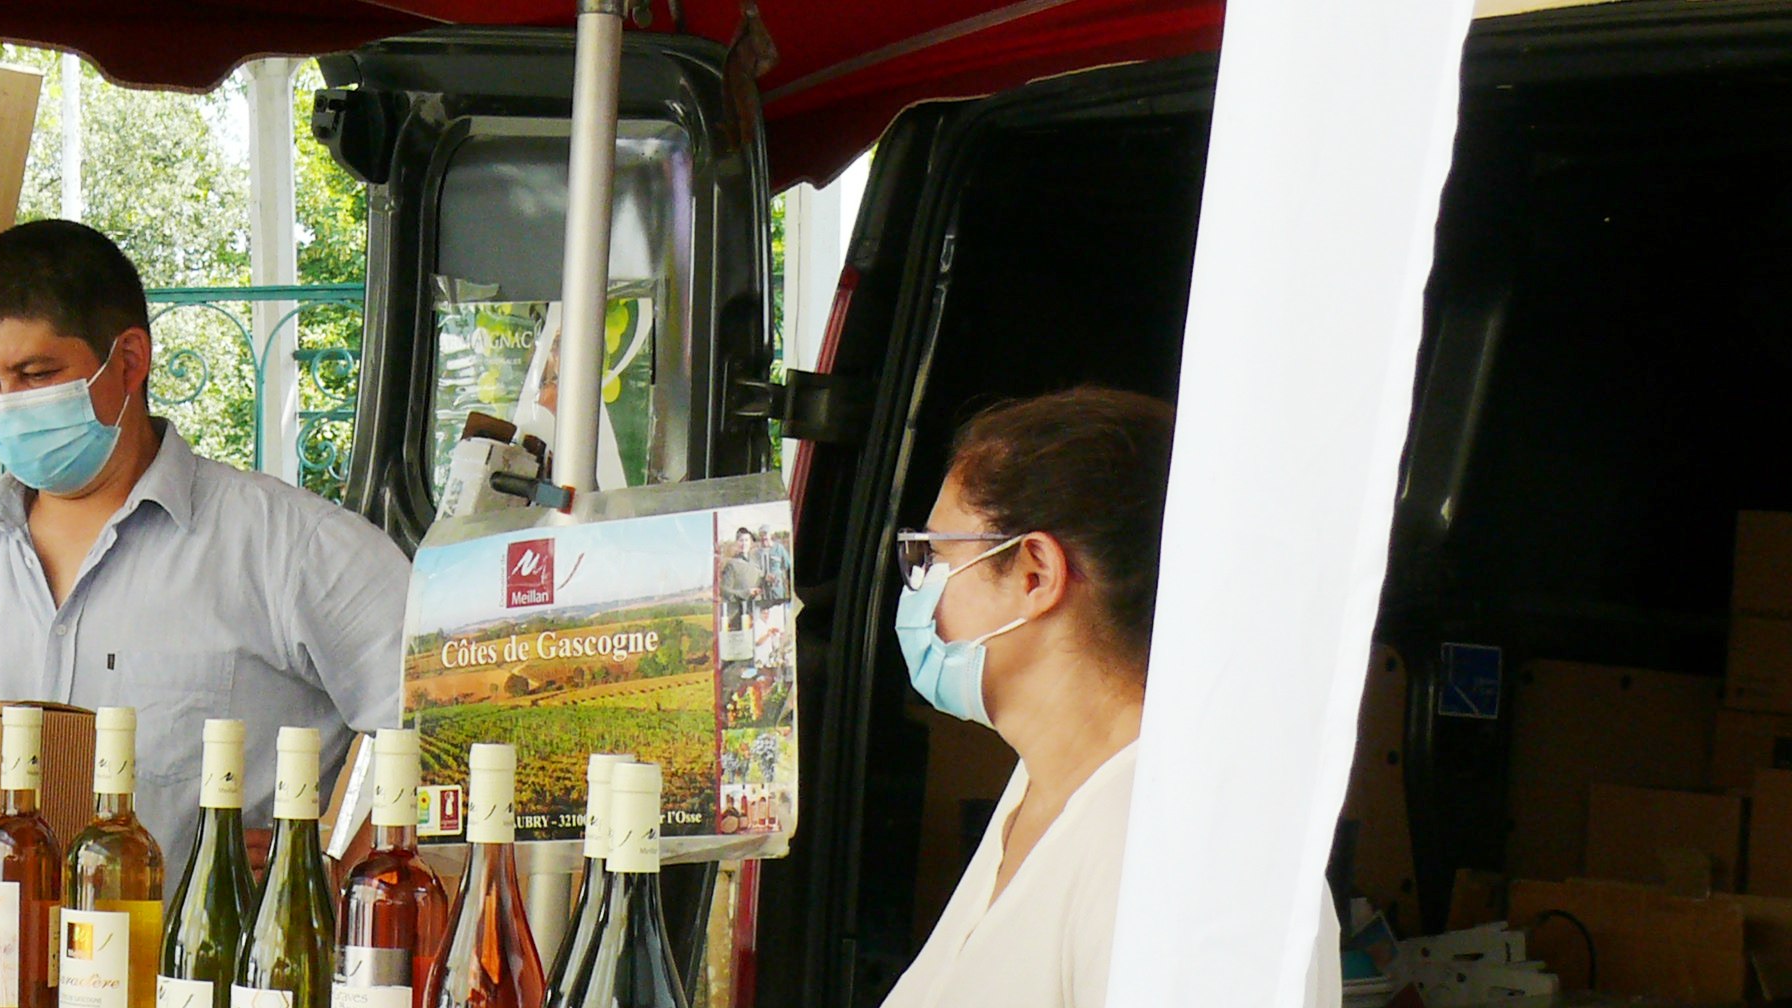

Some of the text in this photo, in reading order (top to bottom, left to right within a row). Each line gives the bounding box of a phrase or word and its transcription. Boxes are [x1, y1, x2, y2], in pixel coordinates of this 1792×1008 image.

[511, 589, 550, 606] Meillan
[441, 630, 659, 668] Côtes de Gascogne
[513, 815, 549, 829] UBRY
